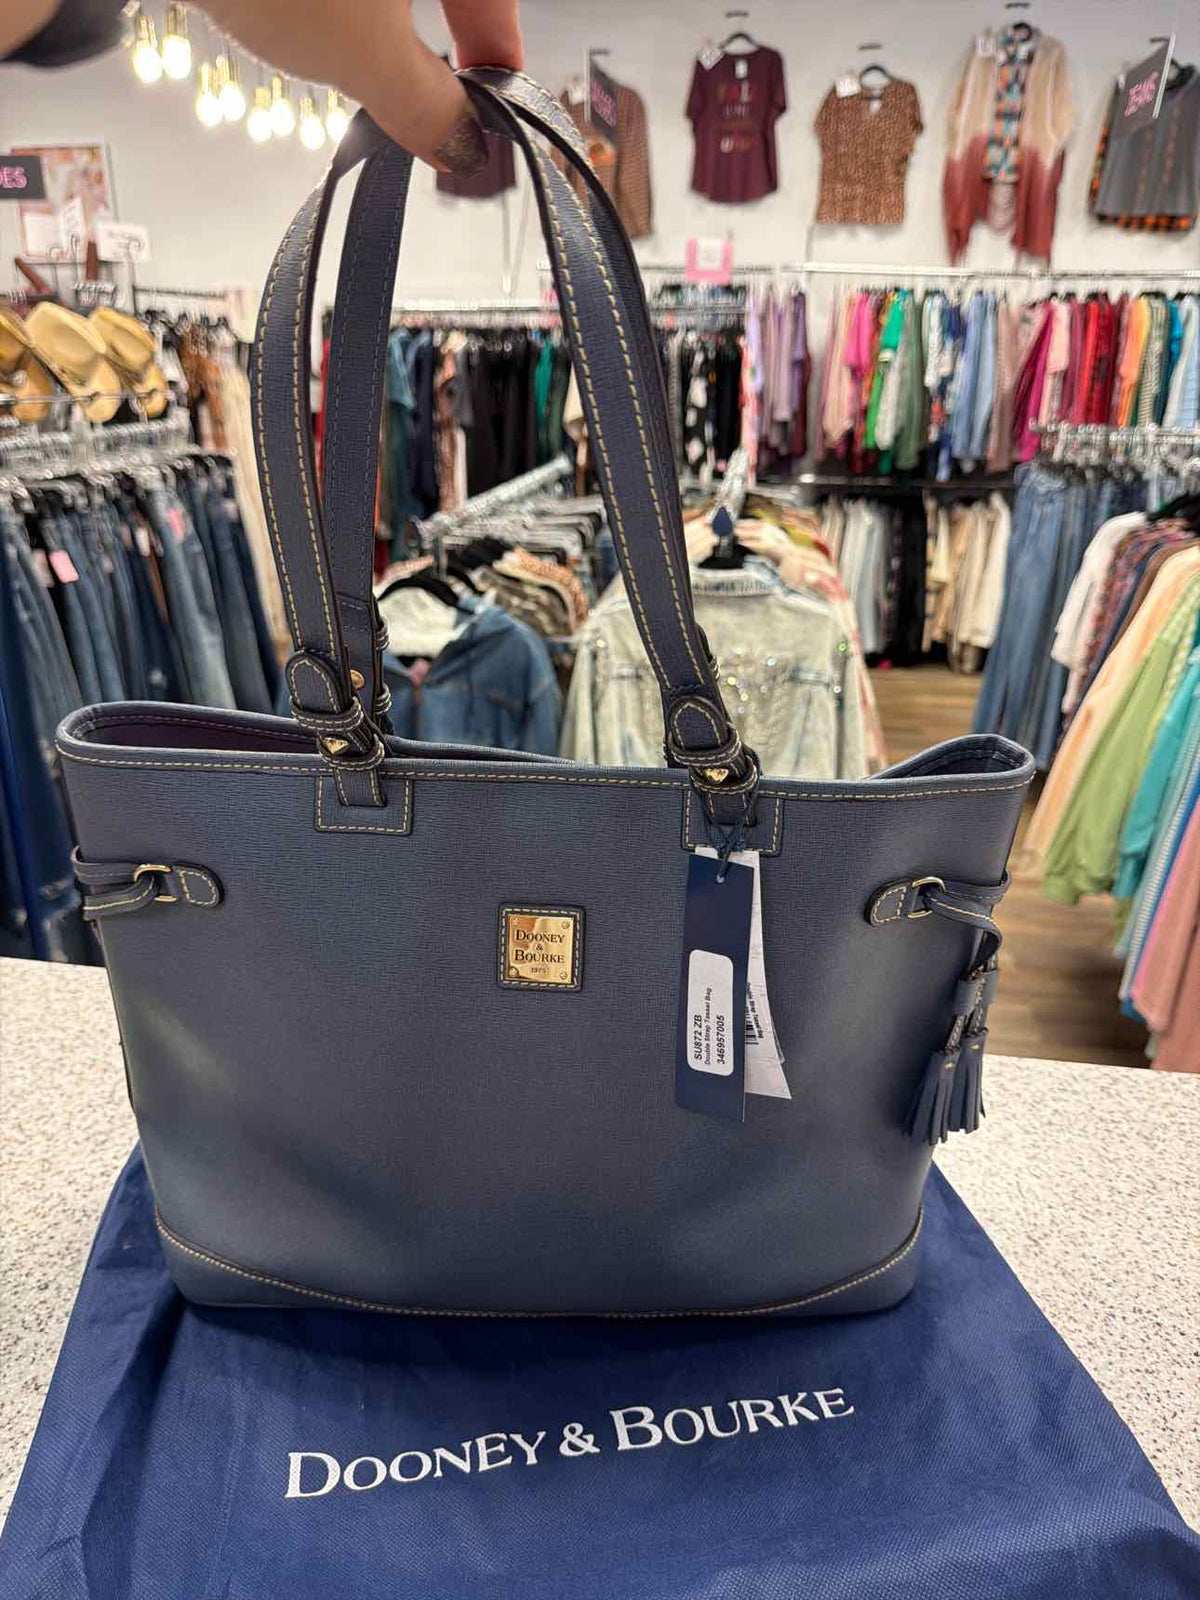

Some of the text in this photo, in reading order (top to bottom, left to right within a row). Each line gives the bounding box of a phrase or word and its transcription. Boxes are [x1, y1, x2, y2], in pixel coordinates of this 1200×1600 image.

[515, 949, 566, 963] BOURKE
[516, 929, 565, 943] DOONEY
[694, 1014, 702, 1060] SU872 ZB
[716, 1015, 725, 1064] 346957005
[284, 1388, 855, 1499] DOONEY & BOURKE
